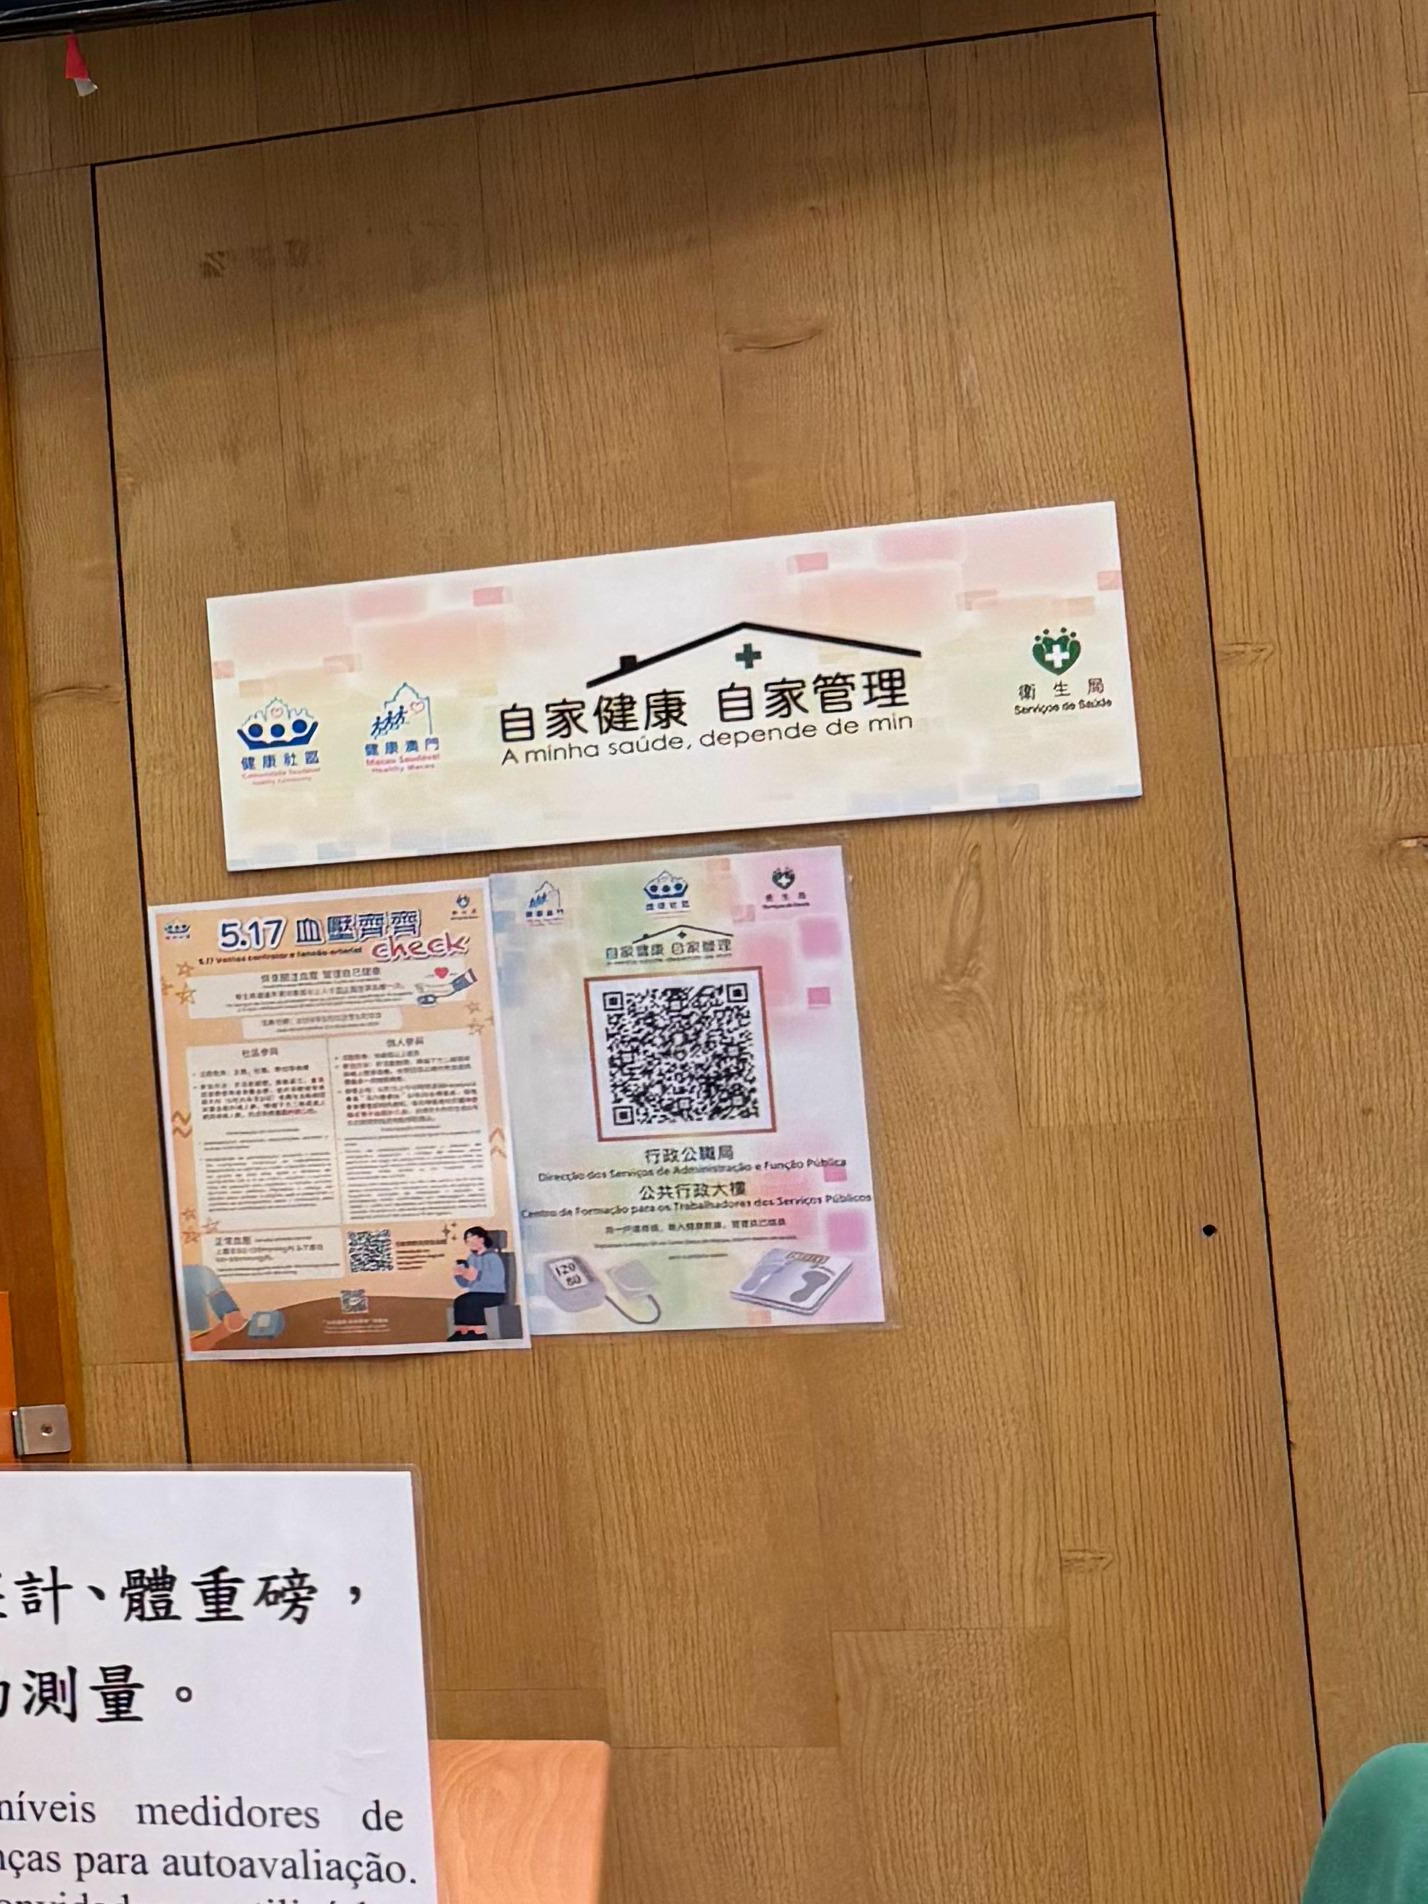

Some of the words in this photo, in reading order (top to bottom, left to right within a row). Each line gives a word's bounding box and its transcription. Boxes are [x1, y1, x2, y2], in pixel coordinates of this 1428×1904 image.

[500, 689, 688, 743] 自家健康
[718, 668, 911, 723] 自家管理
[501, 749, 519, 766] A
[525, 744, 600, 764] minha
[608, 736, 693, 755] saúde,
[700, 721, 817, 749] depende
[826, 716, 859, 736] de
[241, 750, 320, 771] 健康社區
[219, 918, 284, 949] 5.17
[295, 910, 422, 944] 血壓齊齊
[372, 932, 468, 961] check
[645, 1145, 735, 1165] 行政公職局
[639, 1181, 746, 1201] 公共行政大樓
[554, 1262, 576, 1278] 120
[136, 1795, 319, 1828] medidores
[362, 1800, 403, 1831] de
[74, 1852, 149, 1882] para
[163, 1849, 416, 1889] autoavaliação.
